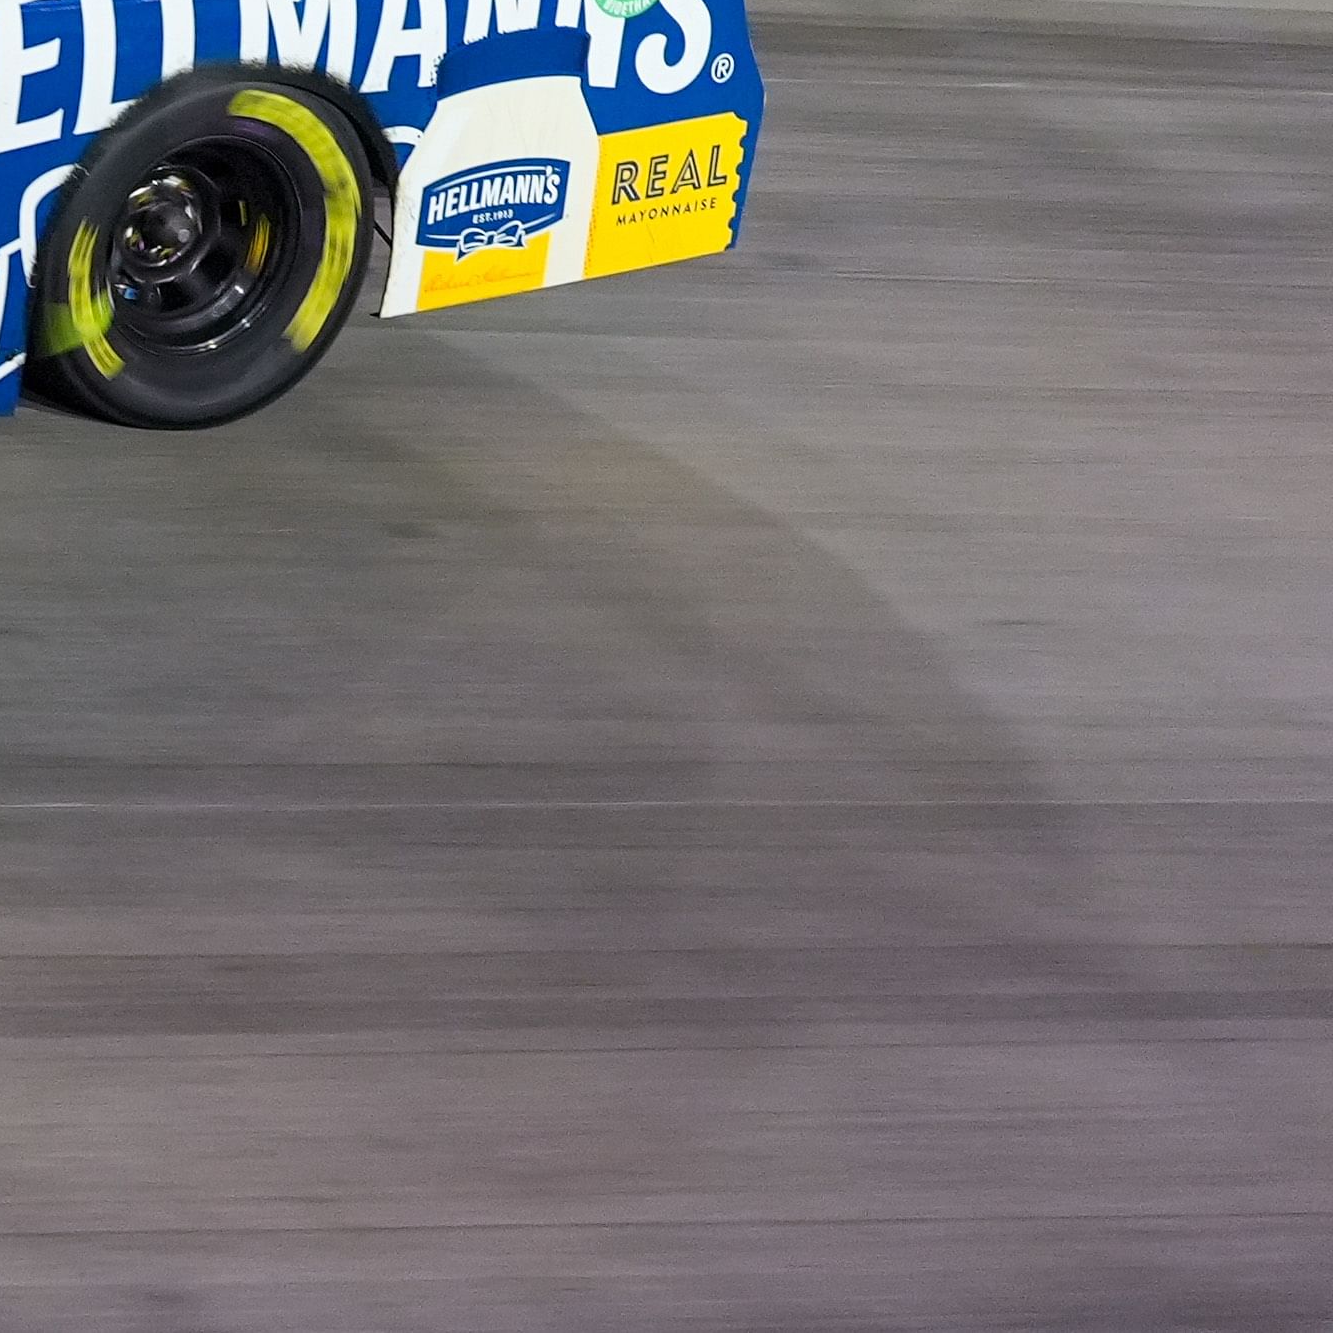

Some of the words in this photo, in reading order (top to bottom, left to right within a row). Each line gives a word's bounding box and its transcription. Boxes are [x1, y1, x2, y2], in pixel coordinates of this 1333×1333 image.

[427, 165, 561, 225] HELLMANN'S
[611, 144, 728, 206] REAL
[616, 197, 718, 226] MAYONNAISE
